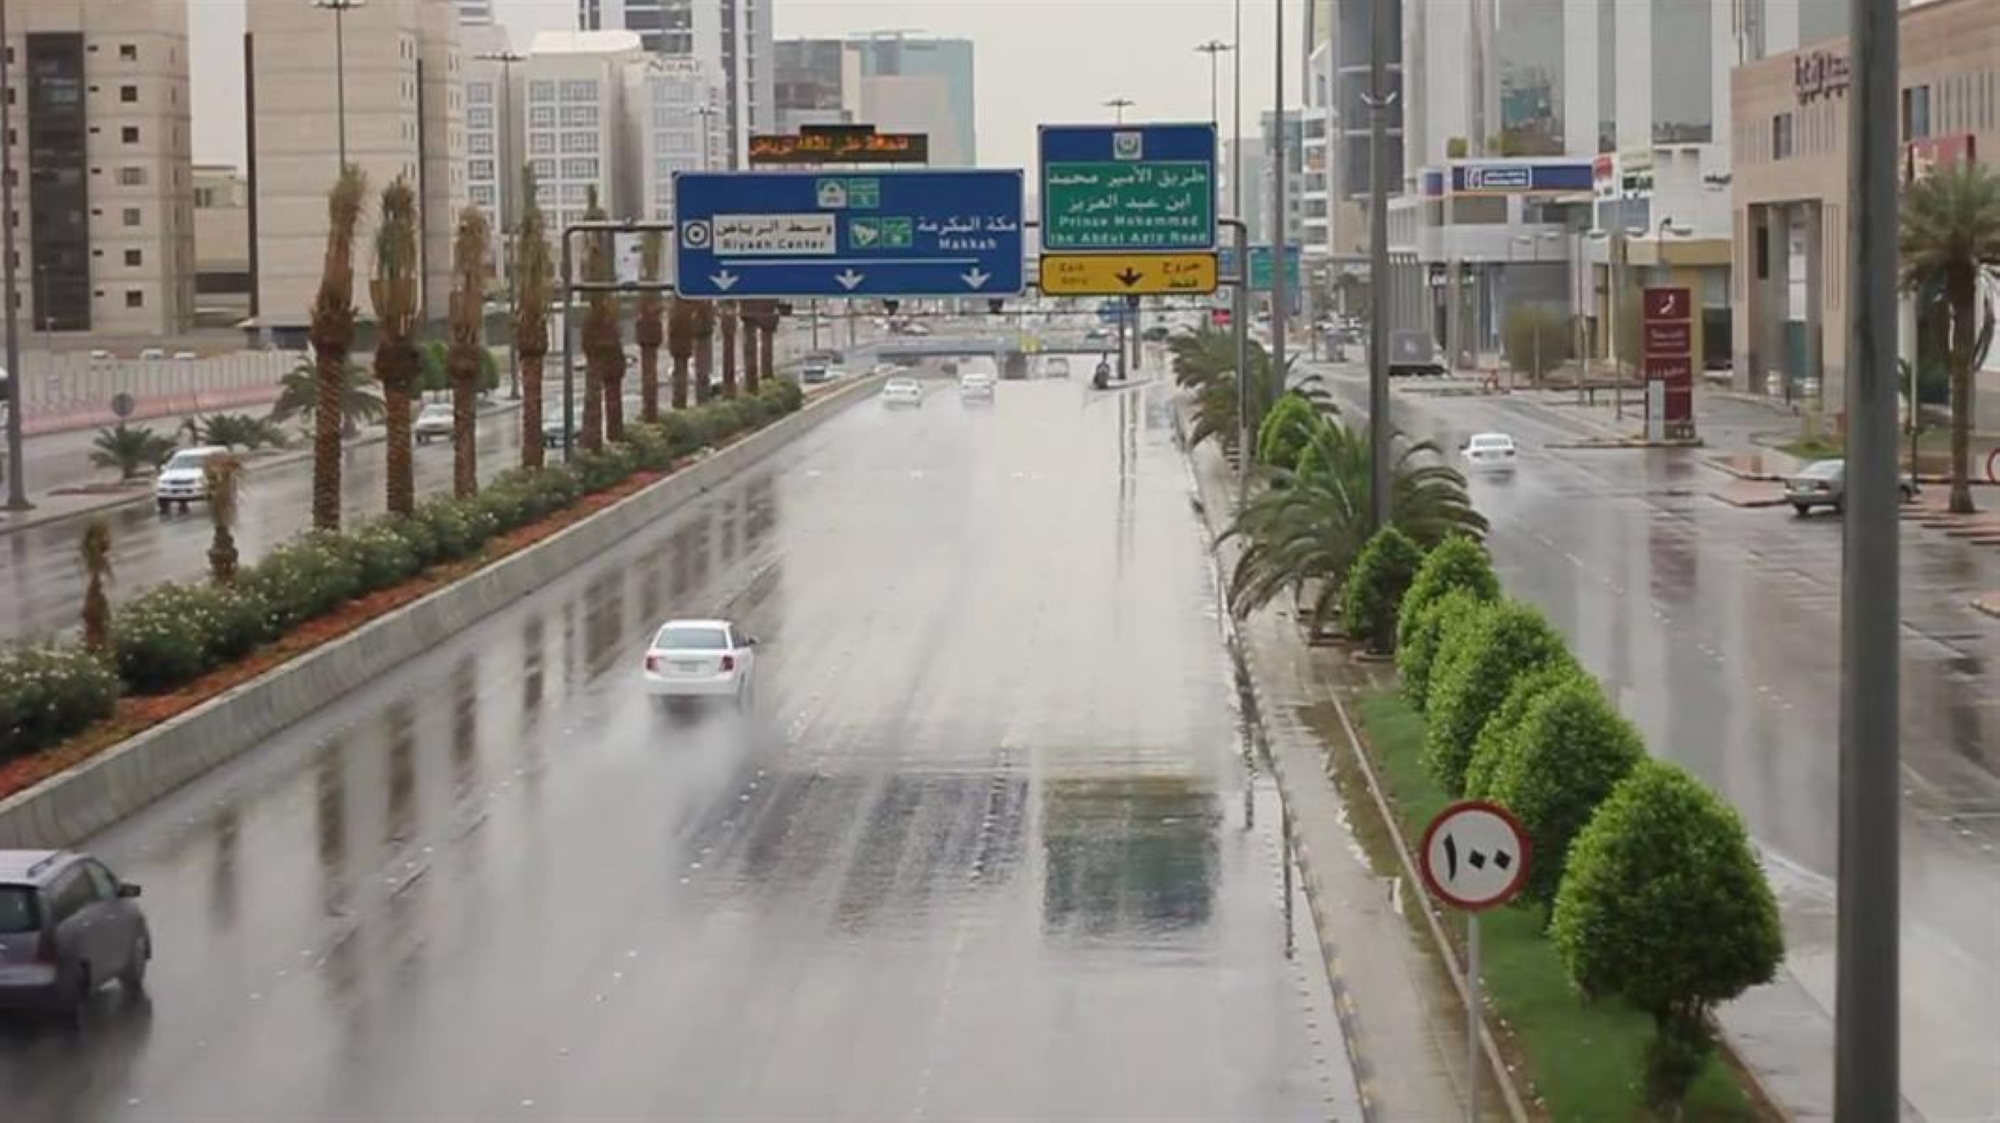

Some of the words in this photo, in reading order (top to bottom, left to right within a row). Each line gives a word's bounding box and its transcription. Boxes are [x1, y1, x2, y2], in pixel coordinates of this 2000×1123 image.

[1048, 173, 1099, 185] محمد
[1157, 167, 1206, 189] طريق
[1164, 192, 1191, 212] ابن
[917, 215, 981, 236] المكرمة
[984, 214, 1017, 232] مكة
[1058, 215, 1109, 228] Prince
[722, 238, 772, 251] Riyadh
[778, 238, 825, 249] Center
[938, 237, 997, 250] Makkah
[1443, 832, 1512, 882] ١٠٠
